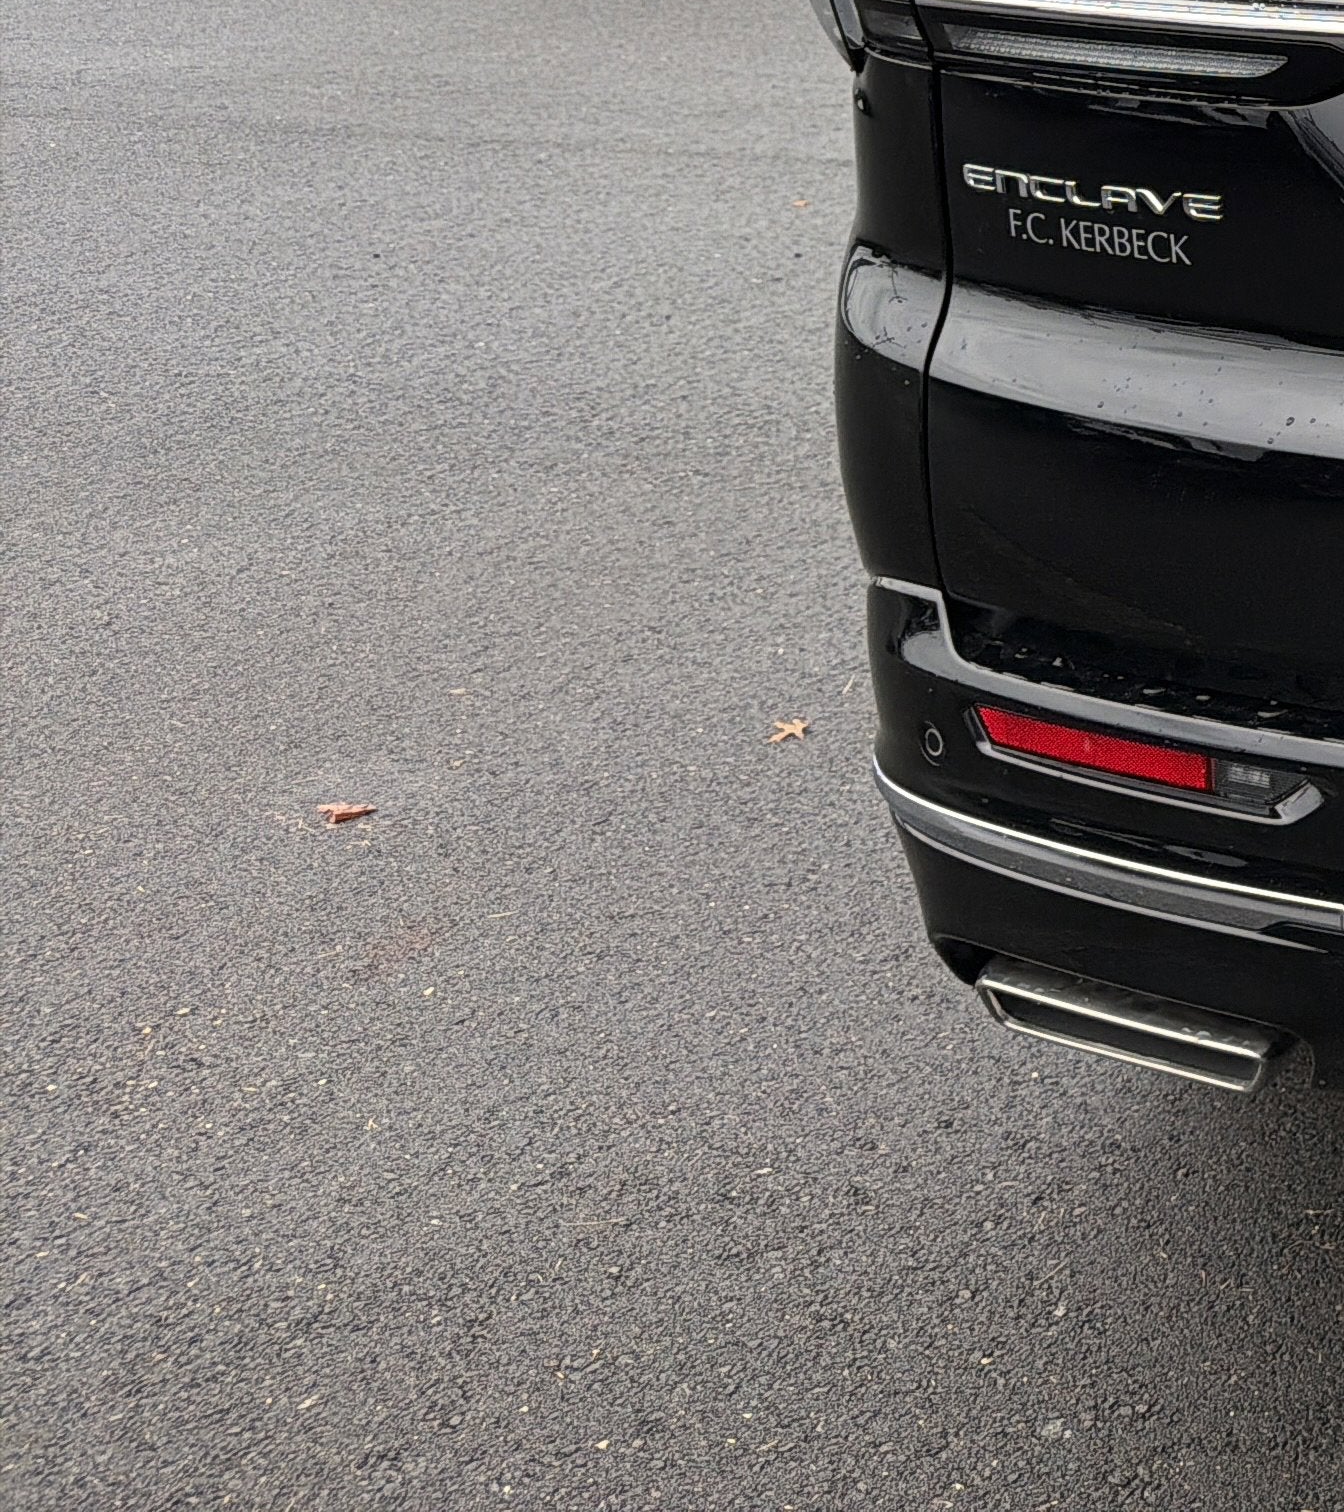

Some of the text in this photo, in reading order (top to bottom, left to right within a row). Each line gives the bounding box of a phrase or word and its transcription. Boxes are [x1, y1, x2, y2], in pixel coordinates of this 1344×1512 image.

[963, 163, 1223, 221] ENCLAVE
[1008, 208, 1192, 265] F.C. KERBECK
